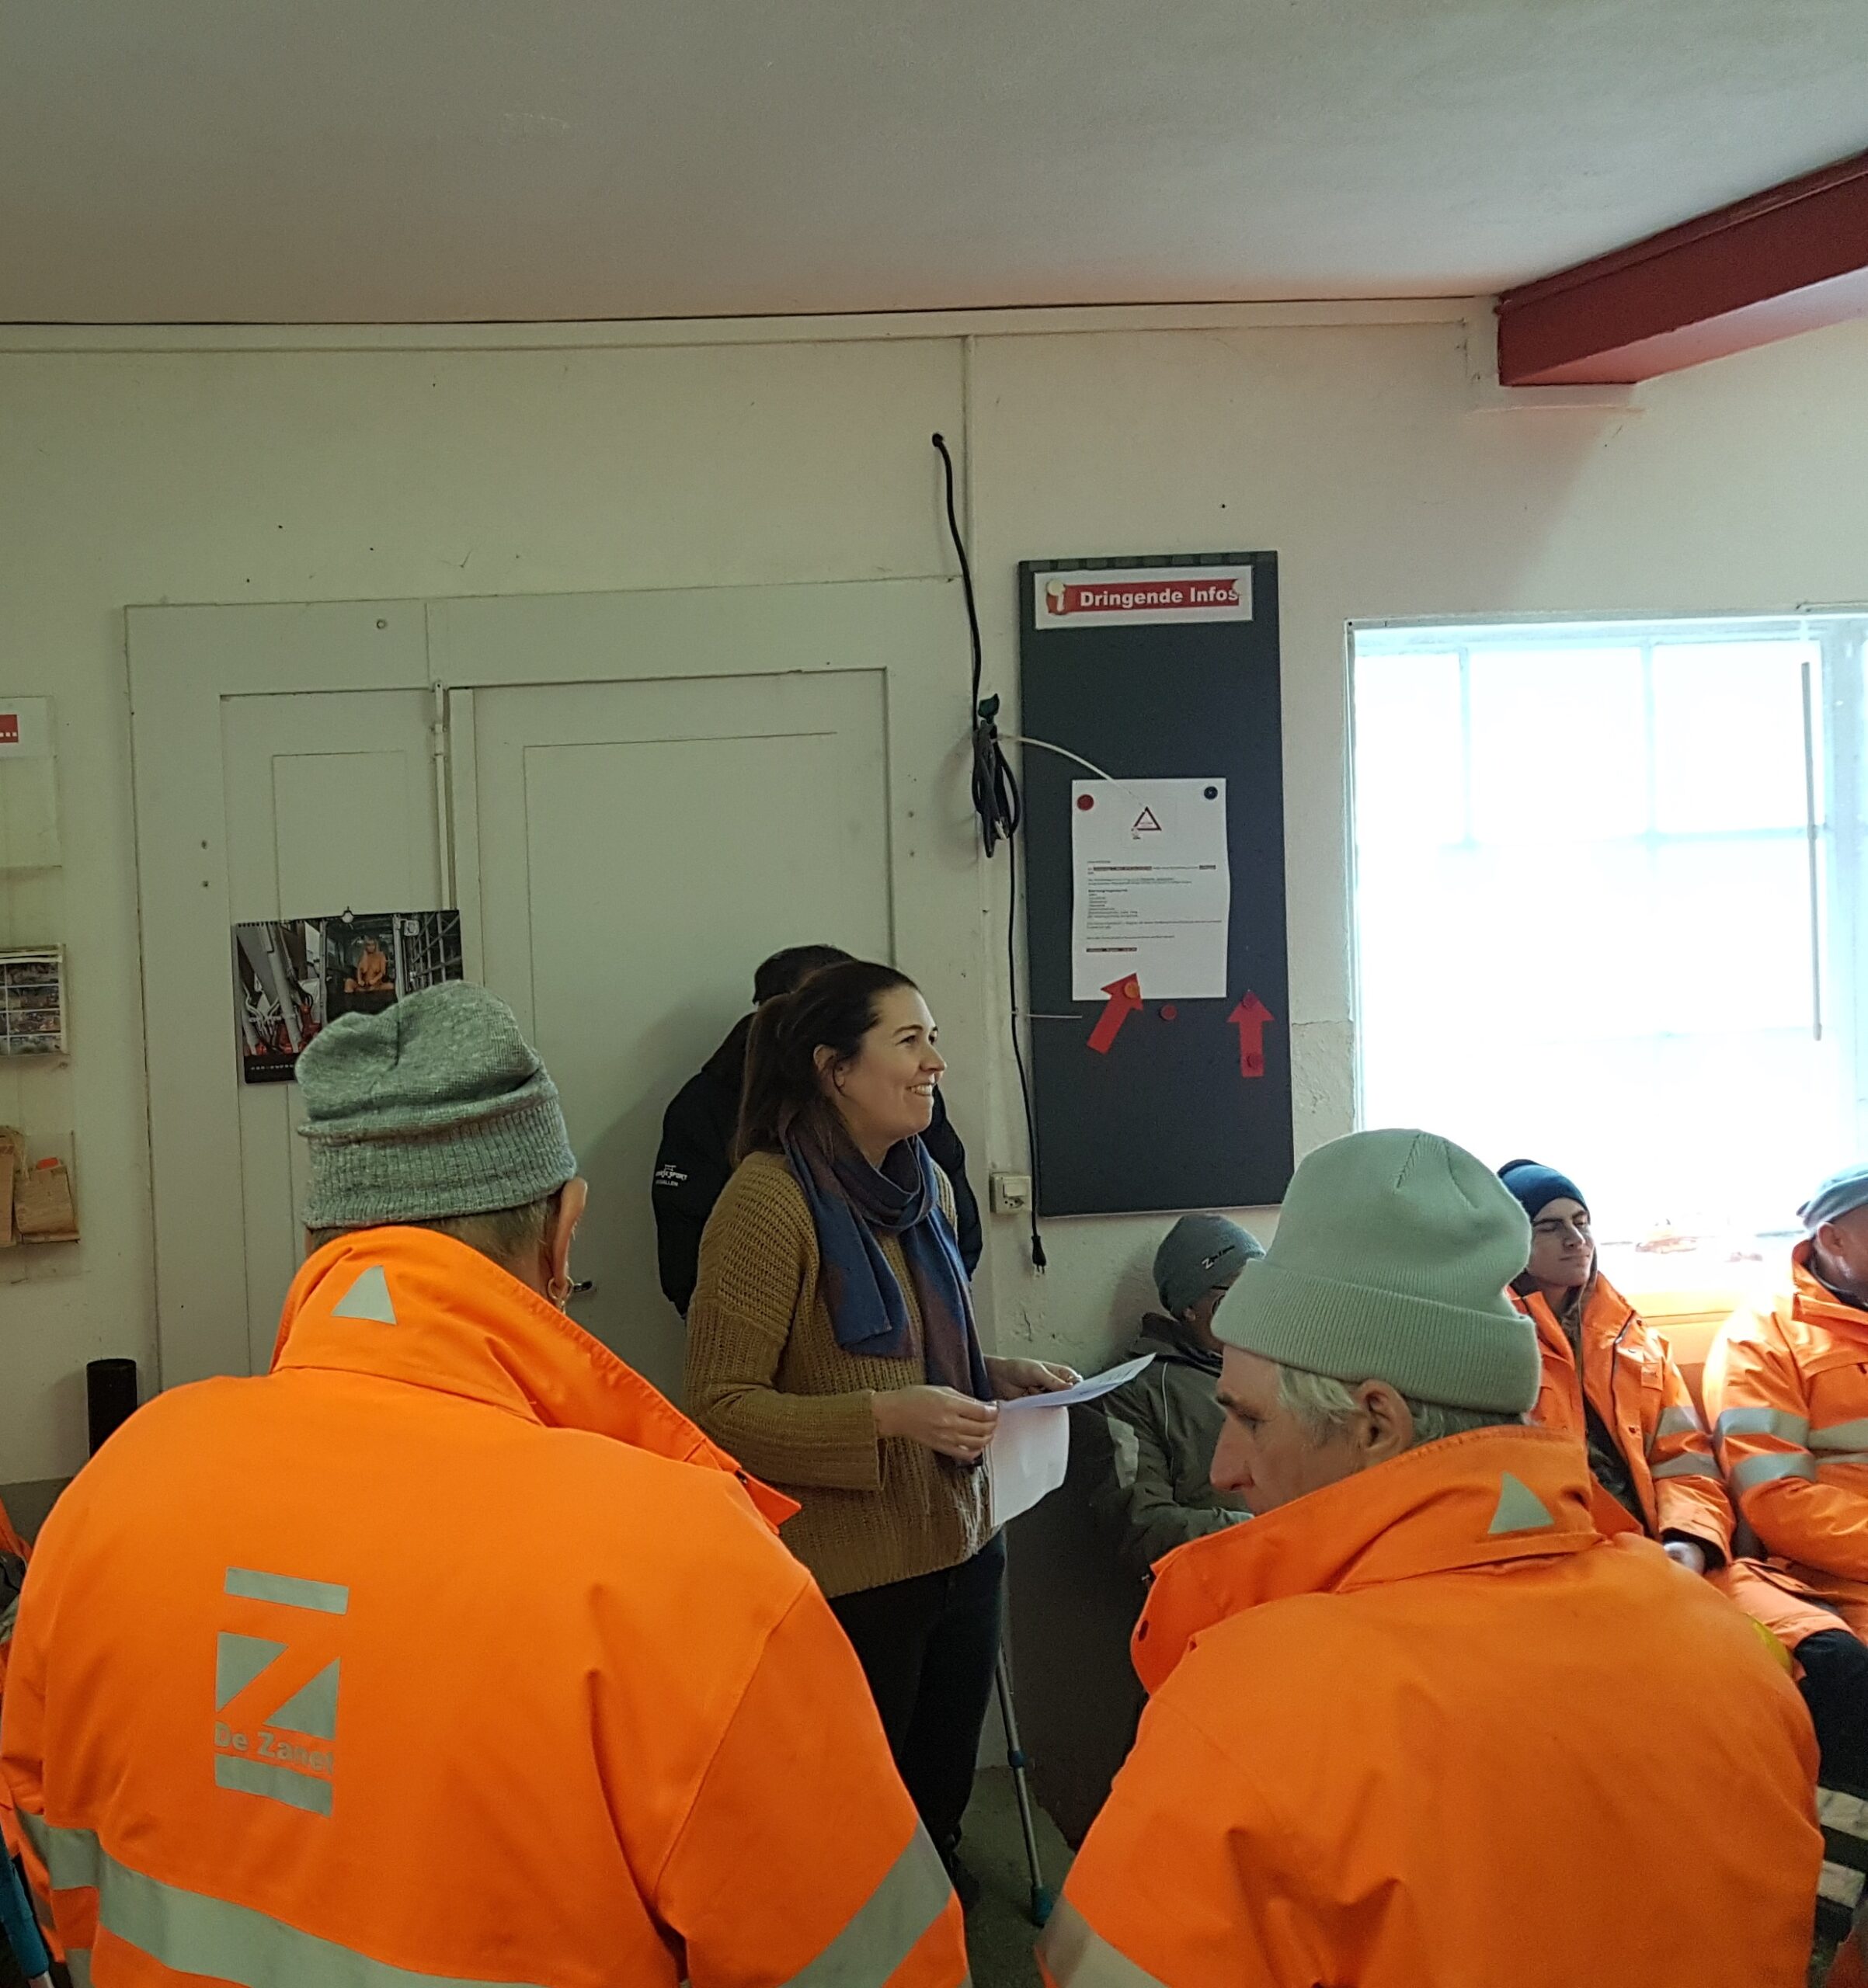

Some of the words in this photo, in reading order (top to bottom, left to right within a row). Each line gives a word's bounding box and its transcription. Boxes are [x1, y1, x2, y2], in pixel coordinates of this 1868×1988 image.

[1080, 589, 1183, 608] Dringende
[1190, 586, 1239, 602] Infos
[214, 1721, 249, 1751] De
